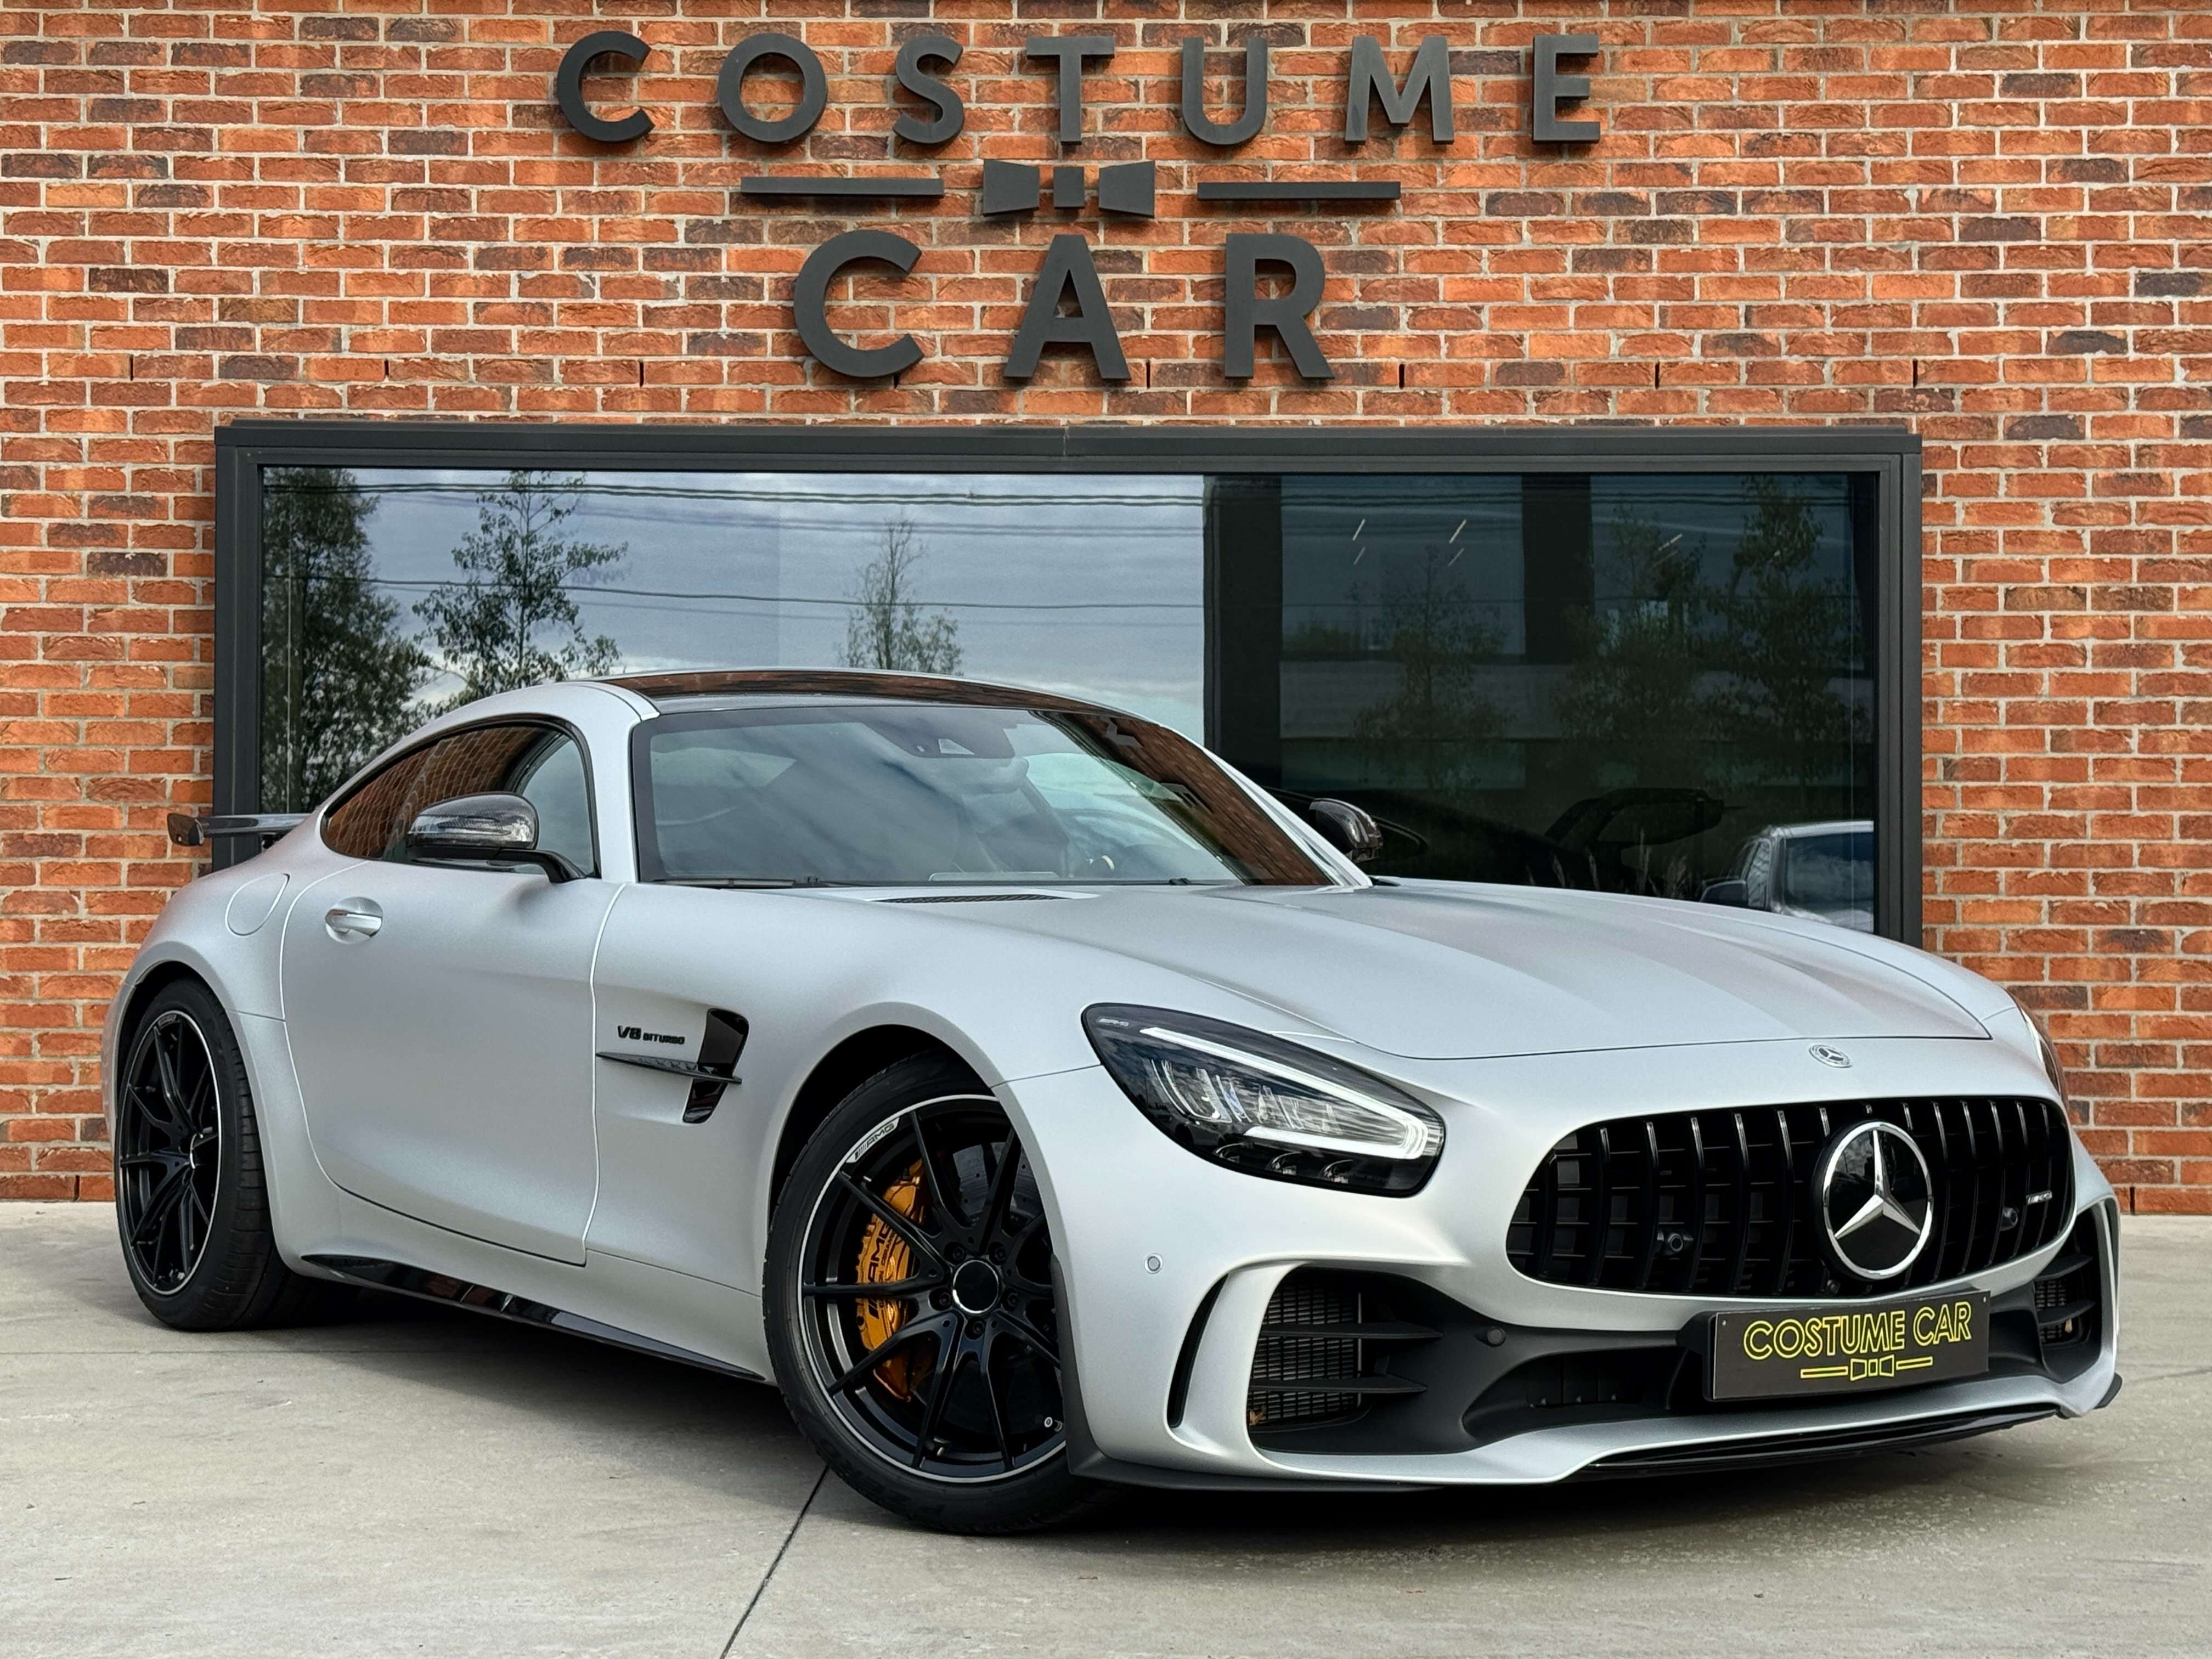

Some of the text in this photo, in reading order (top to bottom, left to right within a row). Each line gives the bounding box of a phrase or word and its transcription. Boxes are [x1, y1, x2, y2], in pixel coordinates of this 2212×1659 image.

[555, 30, 1601, 145] COSTUME
[794, 228, 1335, 380] CAR
[617, 1025, 685, 1045] V8 BITURBO
[865, 1122, 895, 1149] AMG
[1743, 1301, 1972, 1360] COSTUME CAR
